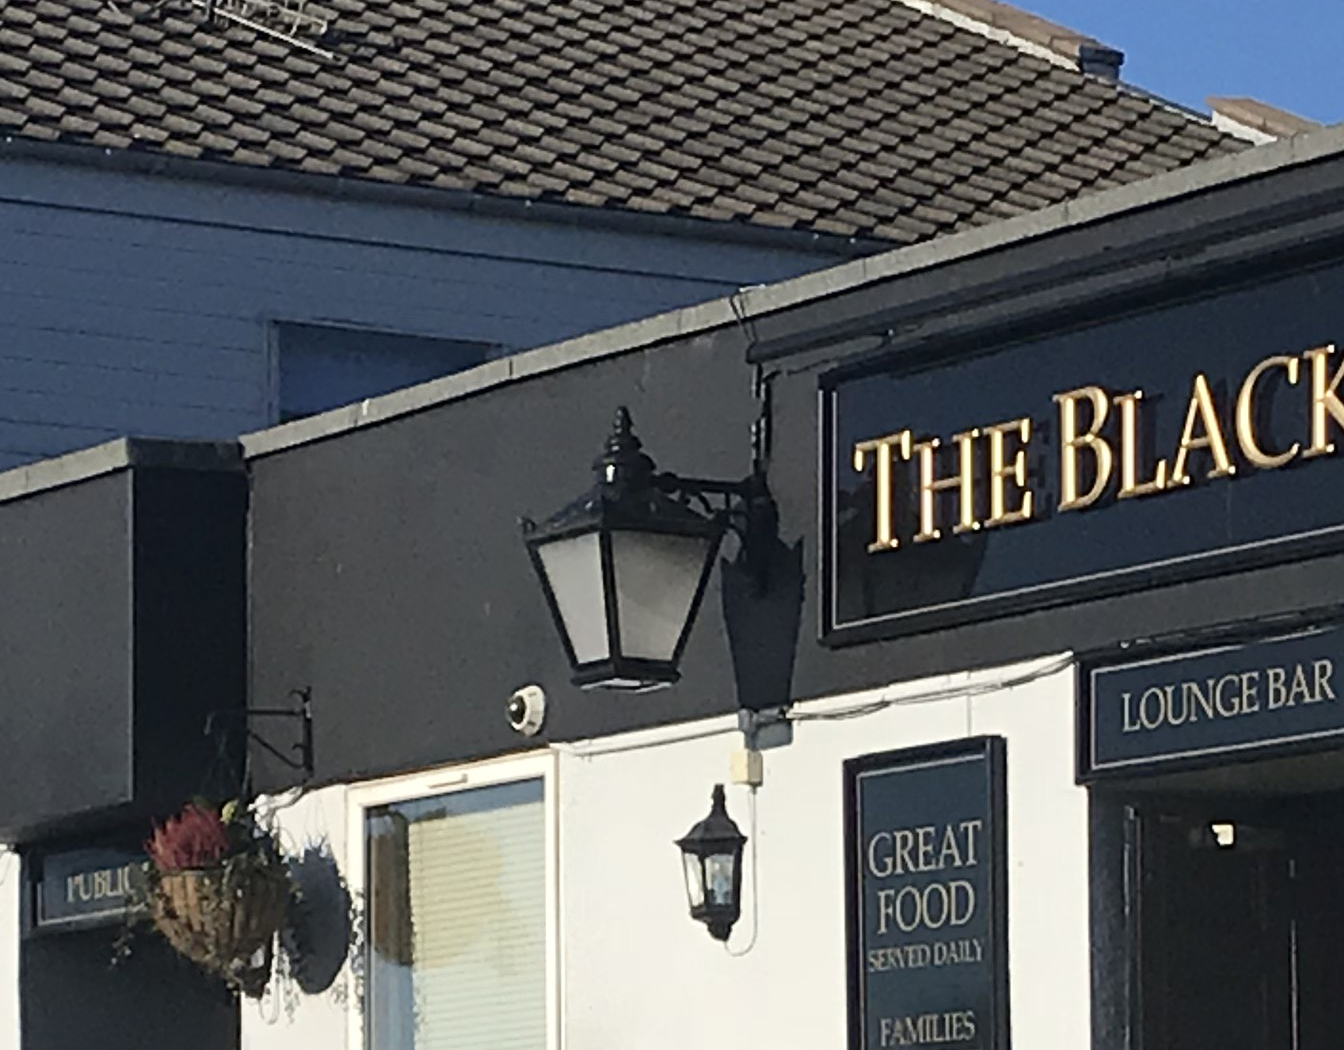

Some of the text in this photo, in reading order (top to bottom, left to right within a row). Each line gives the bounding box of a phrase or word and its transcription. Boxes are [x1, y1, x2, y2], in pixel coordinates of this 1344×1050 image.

[854, 417, 1032, 554] THE
[1122, 659, 1336, 733] LOUNGE BAR
[868, 820, 983, 878] GREAT
[877, 880, 976, 935] FOOD
[868, 938, 985, 973] SERVED DAILY
[879, 1010, 976, 1048] FAMILIES
